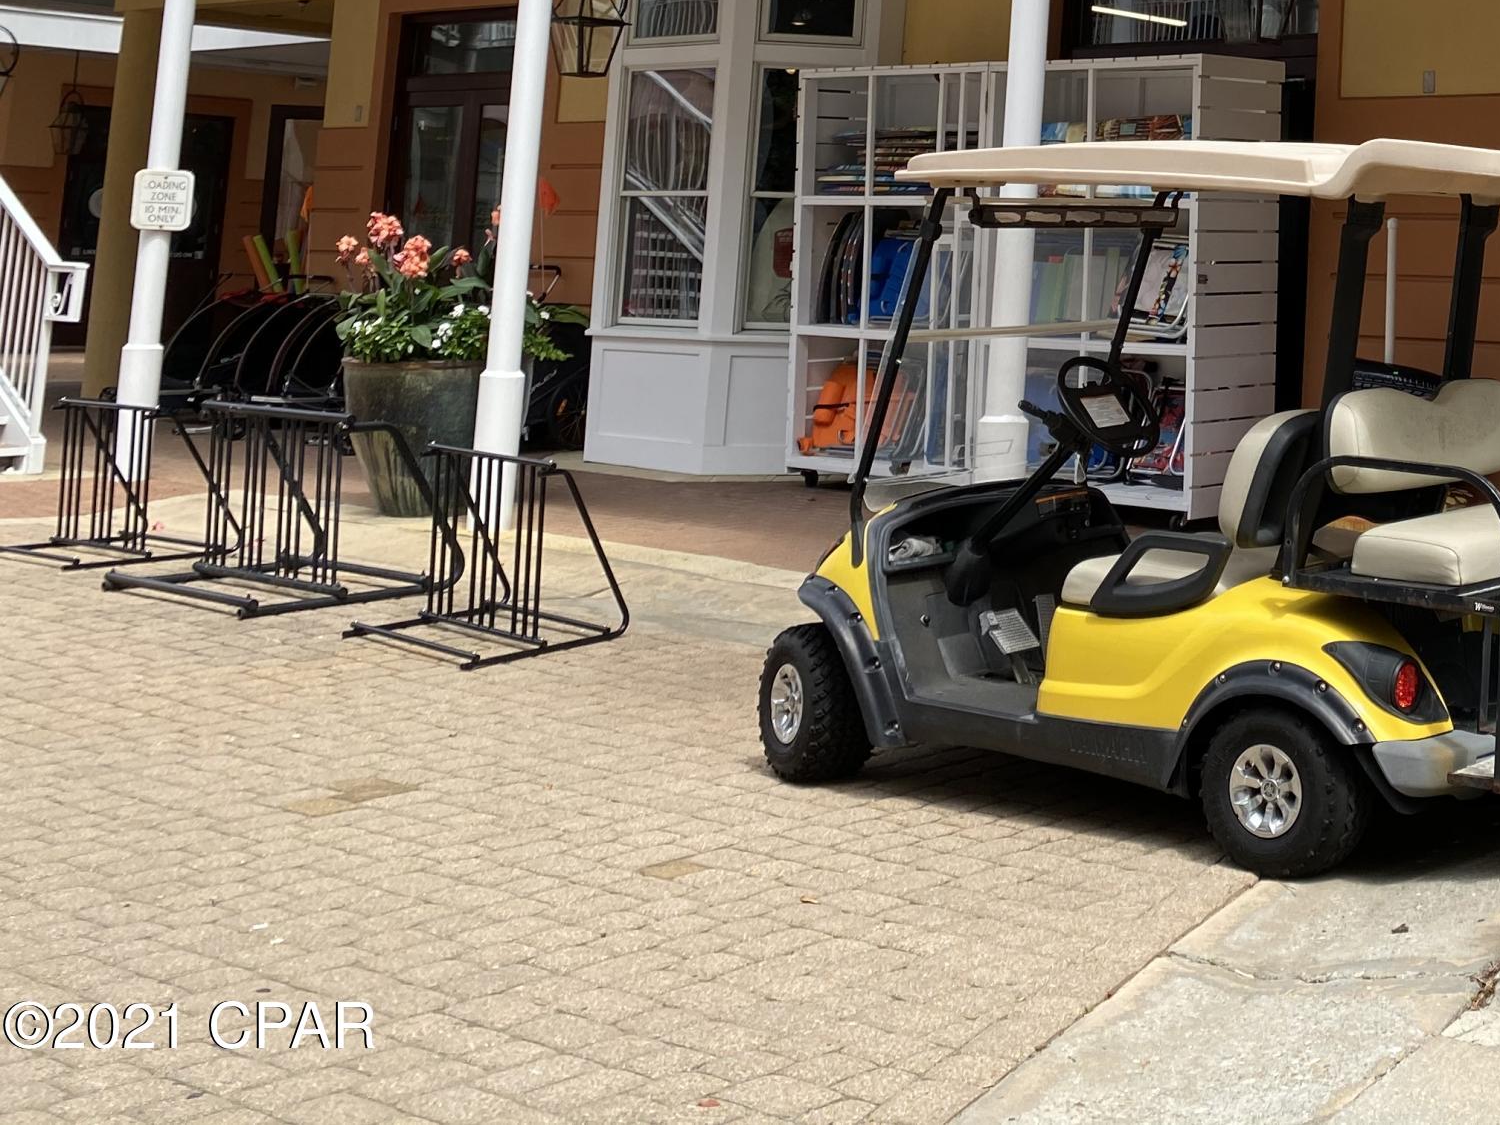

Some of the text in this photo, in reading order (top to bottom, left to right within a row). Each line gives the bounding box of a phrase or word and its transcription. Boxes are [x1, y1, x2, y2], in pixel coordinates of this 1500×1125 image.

[144, 180, 186, 191] OADING
[150, 191, 176, 202] ZONE
[145, 205, 155, 214] 10
[147, 214, 176, 224] ONLY
